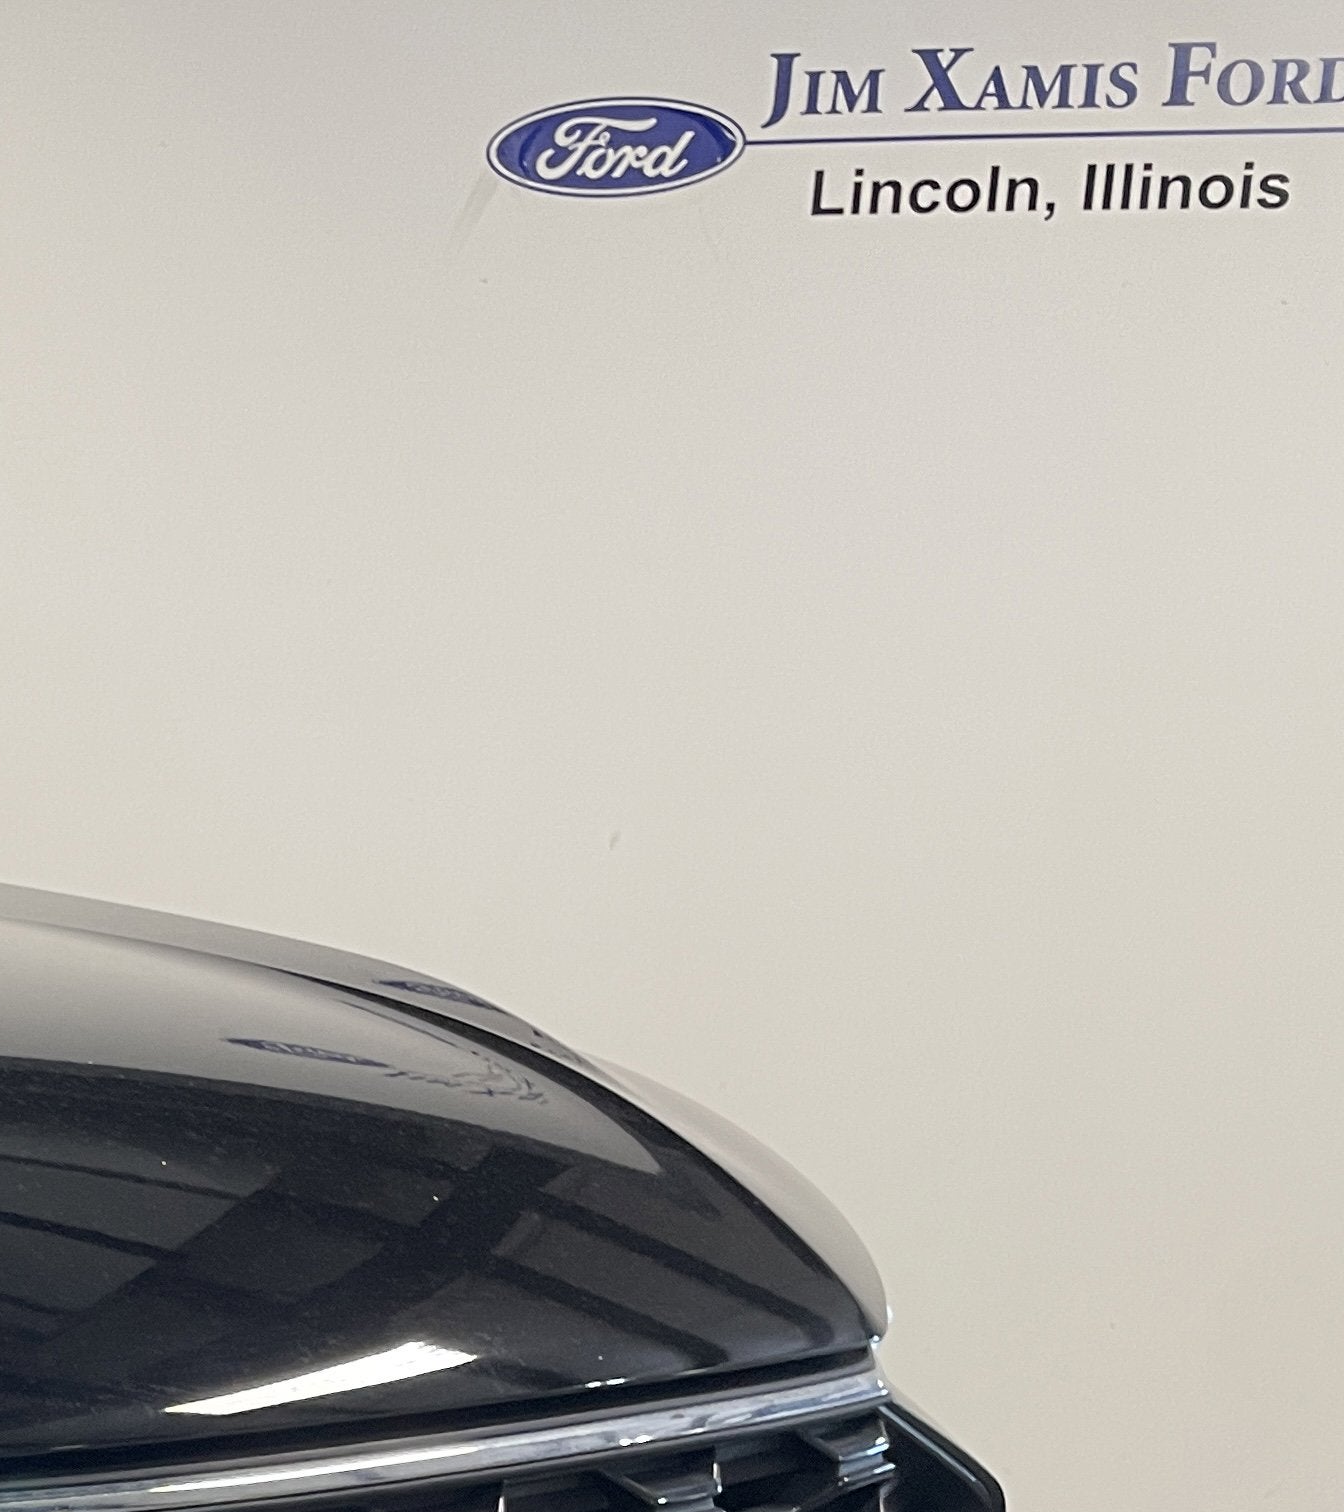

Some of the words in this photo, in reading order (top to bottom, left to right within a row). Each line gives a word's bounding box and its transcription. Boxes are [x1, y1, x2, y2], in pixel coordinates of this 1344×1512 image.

[761, 52, 886, 129] JIM
[903, 47, 1138, 113] XAMIS
[535, 116, 696, 180] Ford
[810, 165, 1056, 222] Lincoln,
[1082, 161, 1290, 211] Illinois
